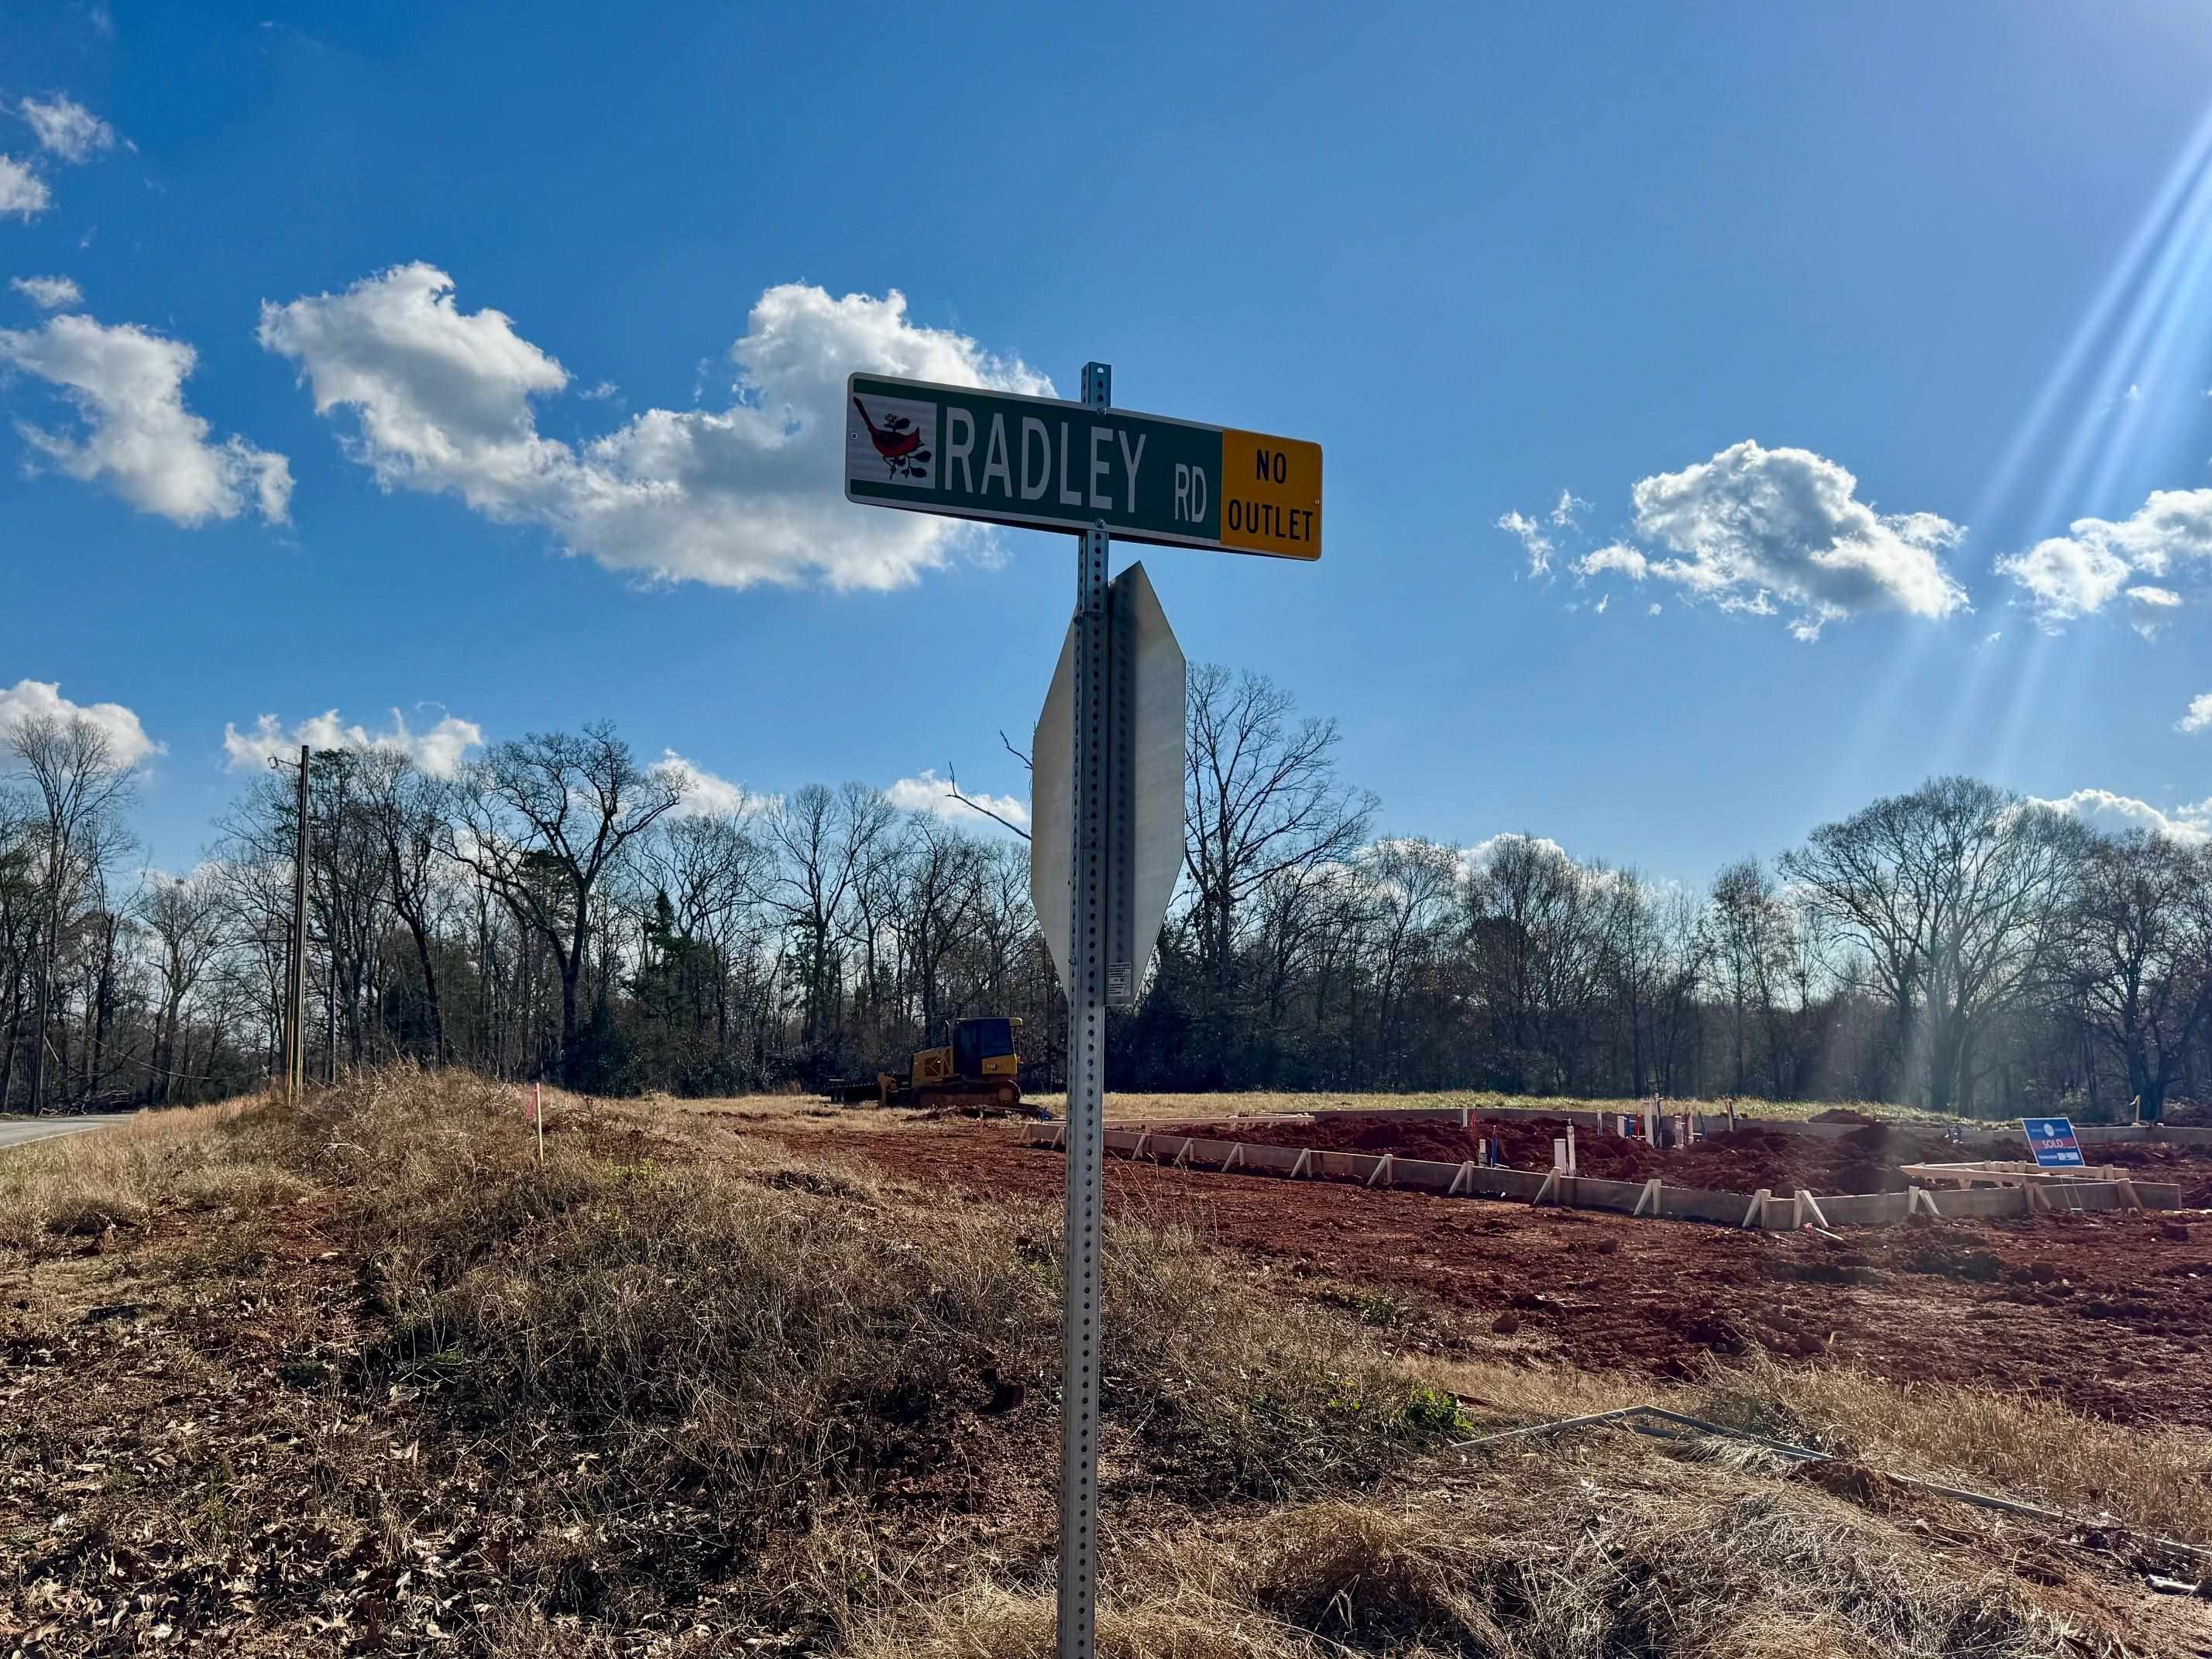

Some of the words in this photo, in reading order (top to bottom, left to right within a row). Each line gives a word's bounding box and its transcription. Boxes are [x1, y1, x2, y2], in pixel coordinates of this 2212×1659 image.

[944, 406, 1147, 514] RADLEY
[1174, 462, 1207, 523] RD
[1255, 448, 1287, 484] NO
[1228, 498, 1314, 541] OUTLET
[2042, 1139, 2063, 1149] SOLD
